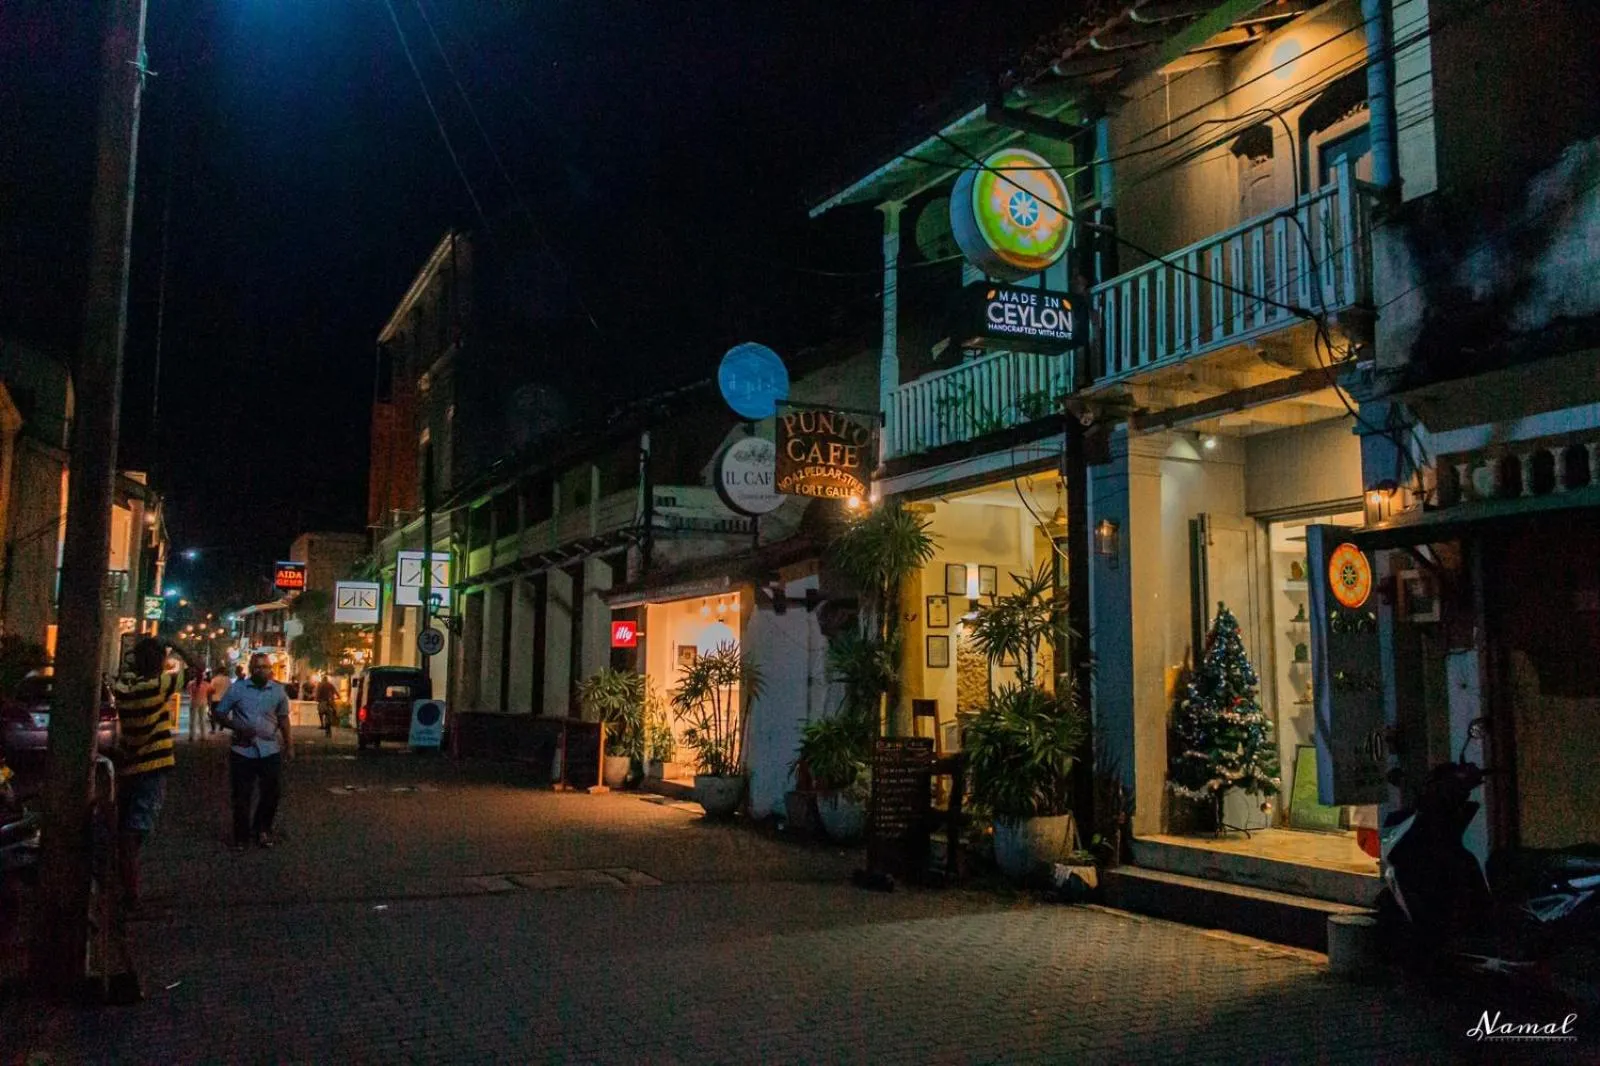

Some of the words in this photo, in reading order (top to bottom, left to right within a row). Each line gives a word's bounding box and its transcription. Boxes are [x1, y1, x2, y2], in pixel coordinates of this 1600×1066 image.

[999, 291, 1037, 305] MADE
[1044, 296, 1060, 309] IN
[987, 302, 1073, 332] CEYLON
[988, 323, 1037, 335] HANDCRAFTED
[1038, 328, 1055, 337] WITH
[1056, 330, 1072, 340] LOVE
[782, 408, 868, 447] PUNTO
[786, 437, 859, 467] CAFE
[726, 471, 741, 485] IL
[743, 471, 776, 486] CAF
[795, 483, 823, 495] FORT
[276, 570, 302, 578] AIDA
[423, 633, 440, 645] 30
[616, 626, 633, 642] illy
